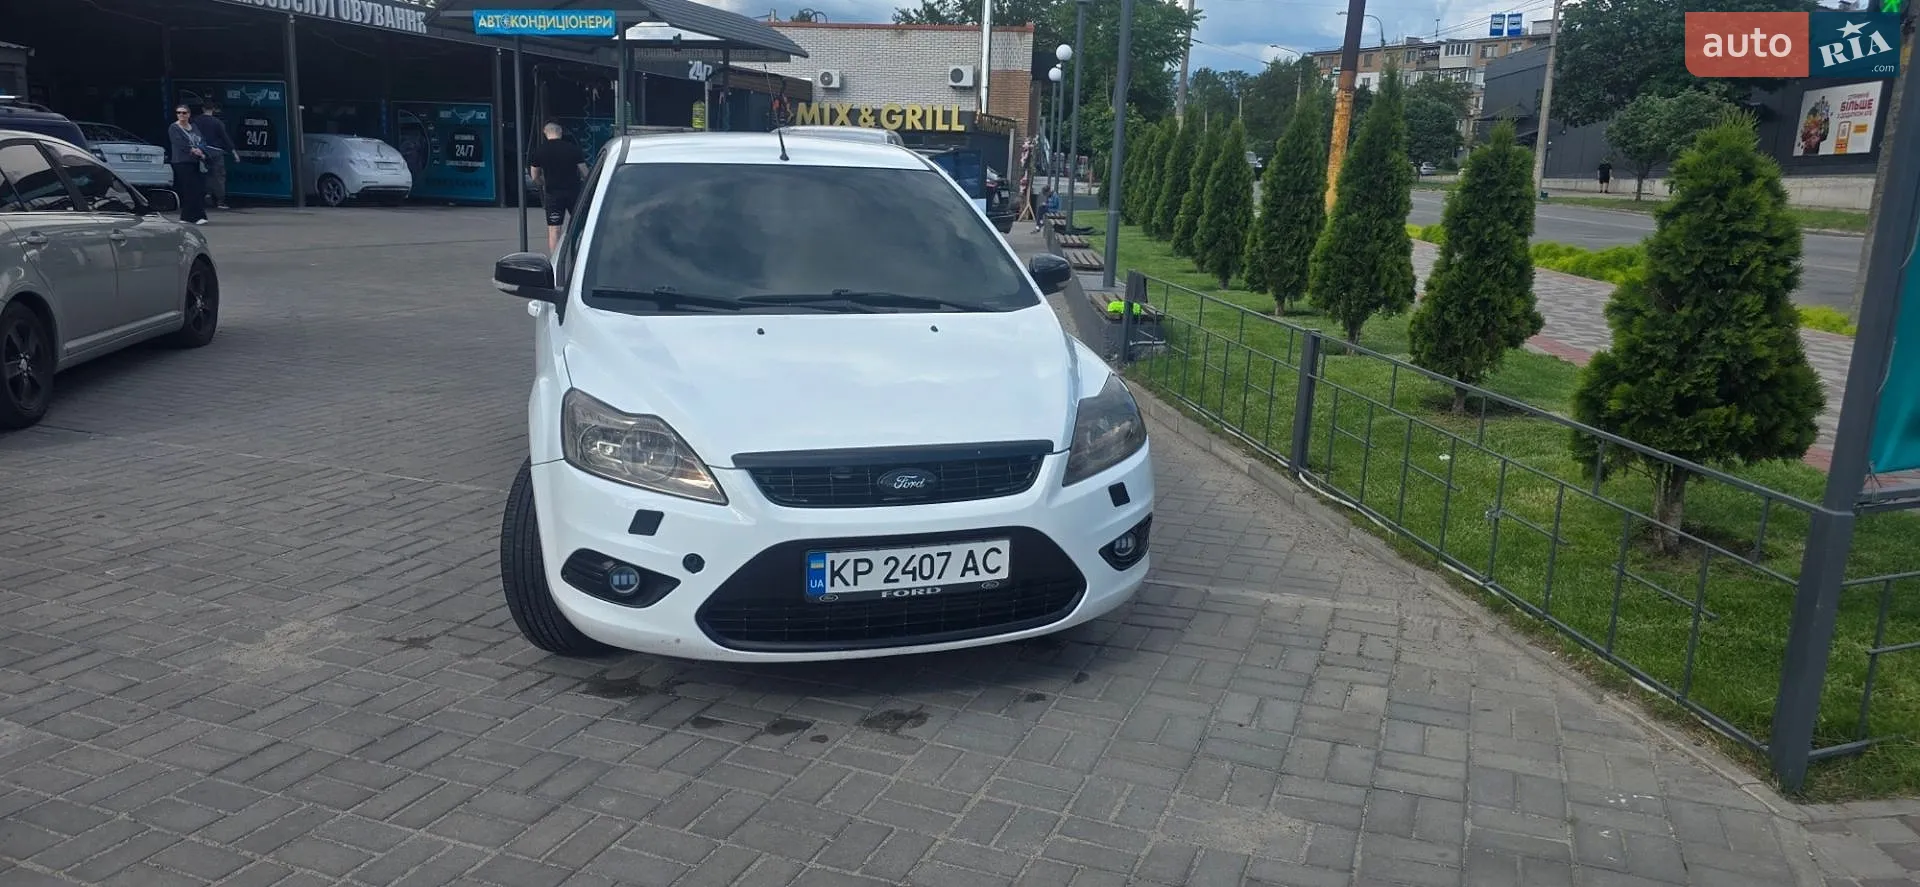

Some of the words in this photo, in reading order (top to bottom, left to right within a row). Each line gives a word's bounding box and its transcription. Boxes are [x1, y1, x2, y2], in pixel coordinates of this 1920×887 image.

[1840, 99, 1874, 112] БІЛЬШЕ
[796, 102, 853, 126] MIX
[857, 104, 876, 128] &
[880, 103, 966, 131] GRILL
[246, 130, 268, 146] 24/7
[455, 144, 475, 157] 24/7
[893, 475, 926, 489] Ford
[829, 558, 874, 588] KP
[883, 551, 952, 584] 2407
[959, 547, 1003, 578] AC
[810, 579, 824, 589] UA
[881, 586, 942, 598] FORD
